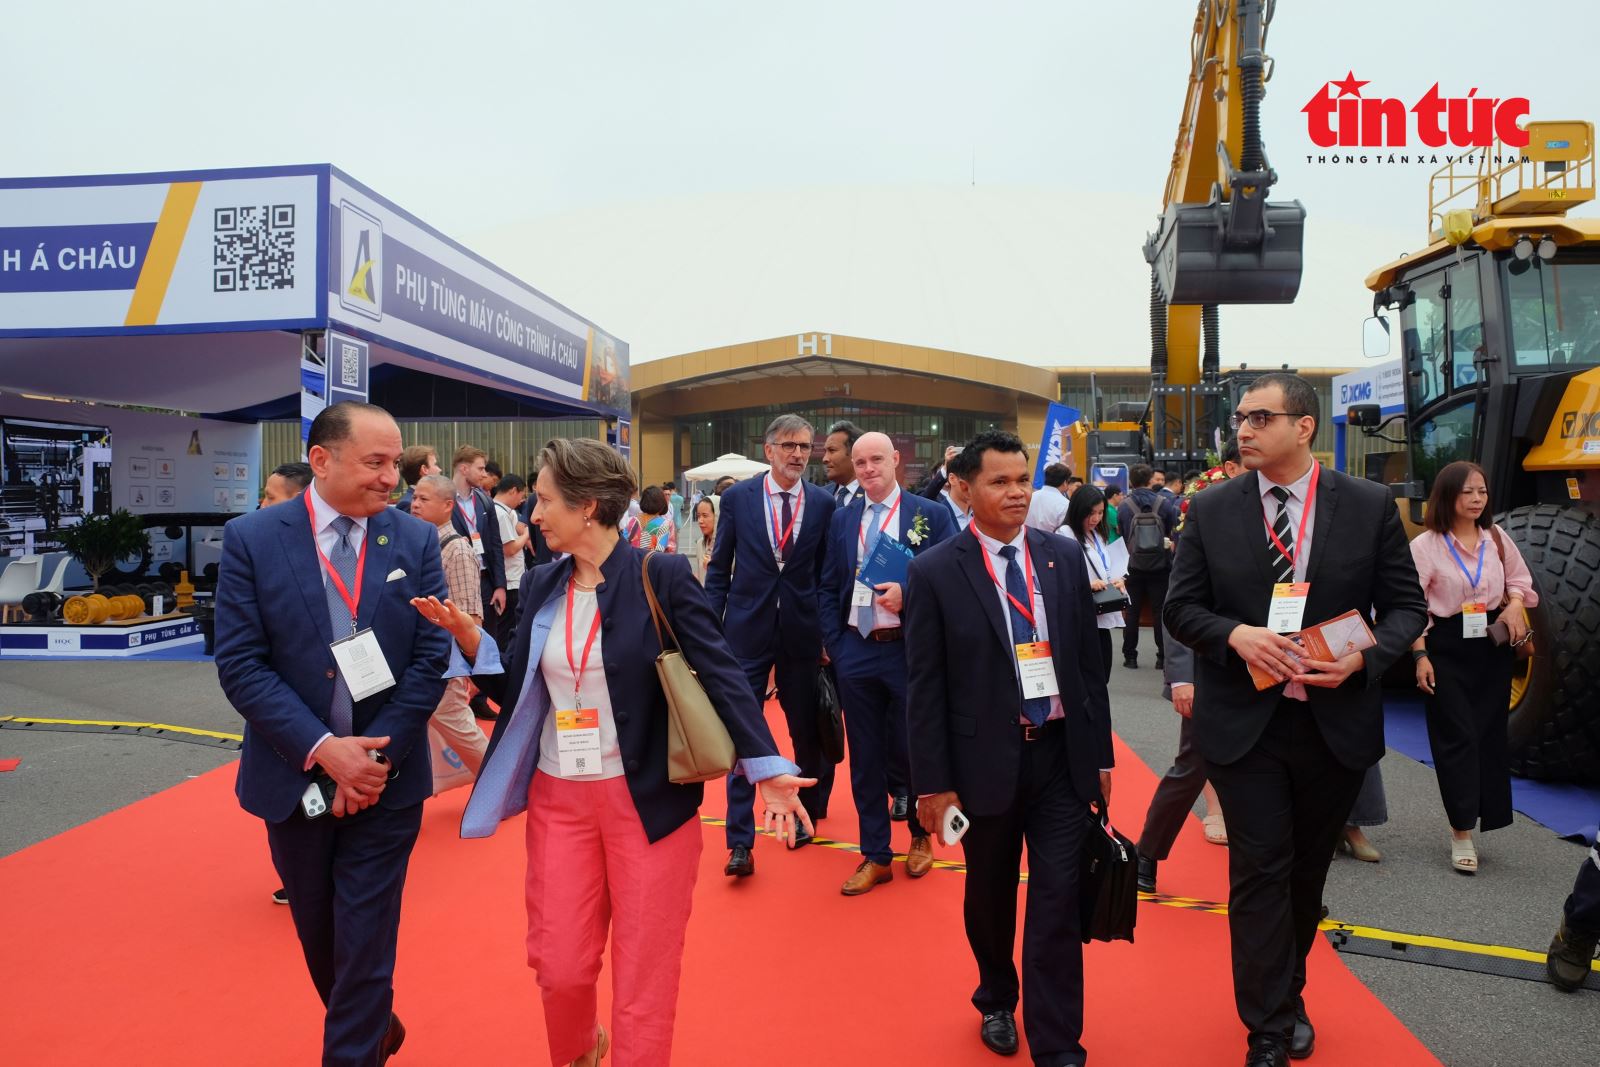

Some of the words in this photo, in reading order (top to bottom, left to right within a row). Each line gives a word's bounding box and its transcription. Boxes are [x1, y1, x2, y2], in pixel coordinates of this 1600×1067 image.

[30, 243, 50, 271] Á
[57, 241, 137, 271] CHÂU
[396, 263, 426, 312] PHỤ
[431, 276, 467, 323] TÙNG
[470, 299, 494, 333] MÁY
[496, 310, 523, 347] CÔNG
[525, 325, 550, 358] TRÌNH
[551, 334, 557, 361] Á
[558, 341, 578, 370] CHÂU
[798, 334, 832, 355] H1
[1348, 381, 1372, 403] XCMG
[145, 633, 157, 641] PHỤ
[161, 629, 176, 639] TÙNG
